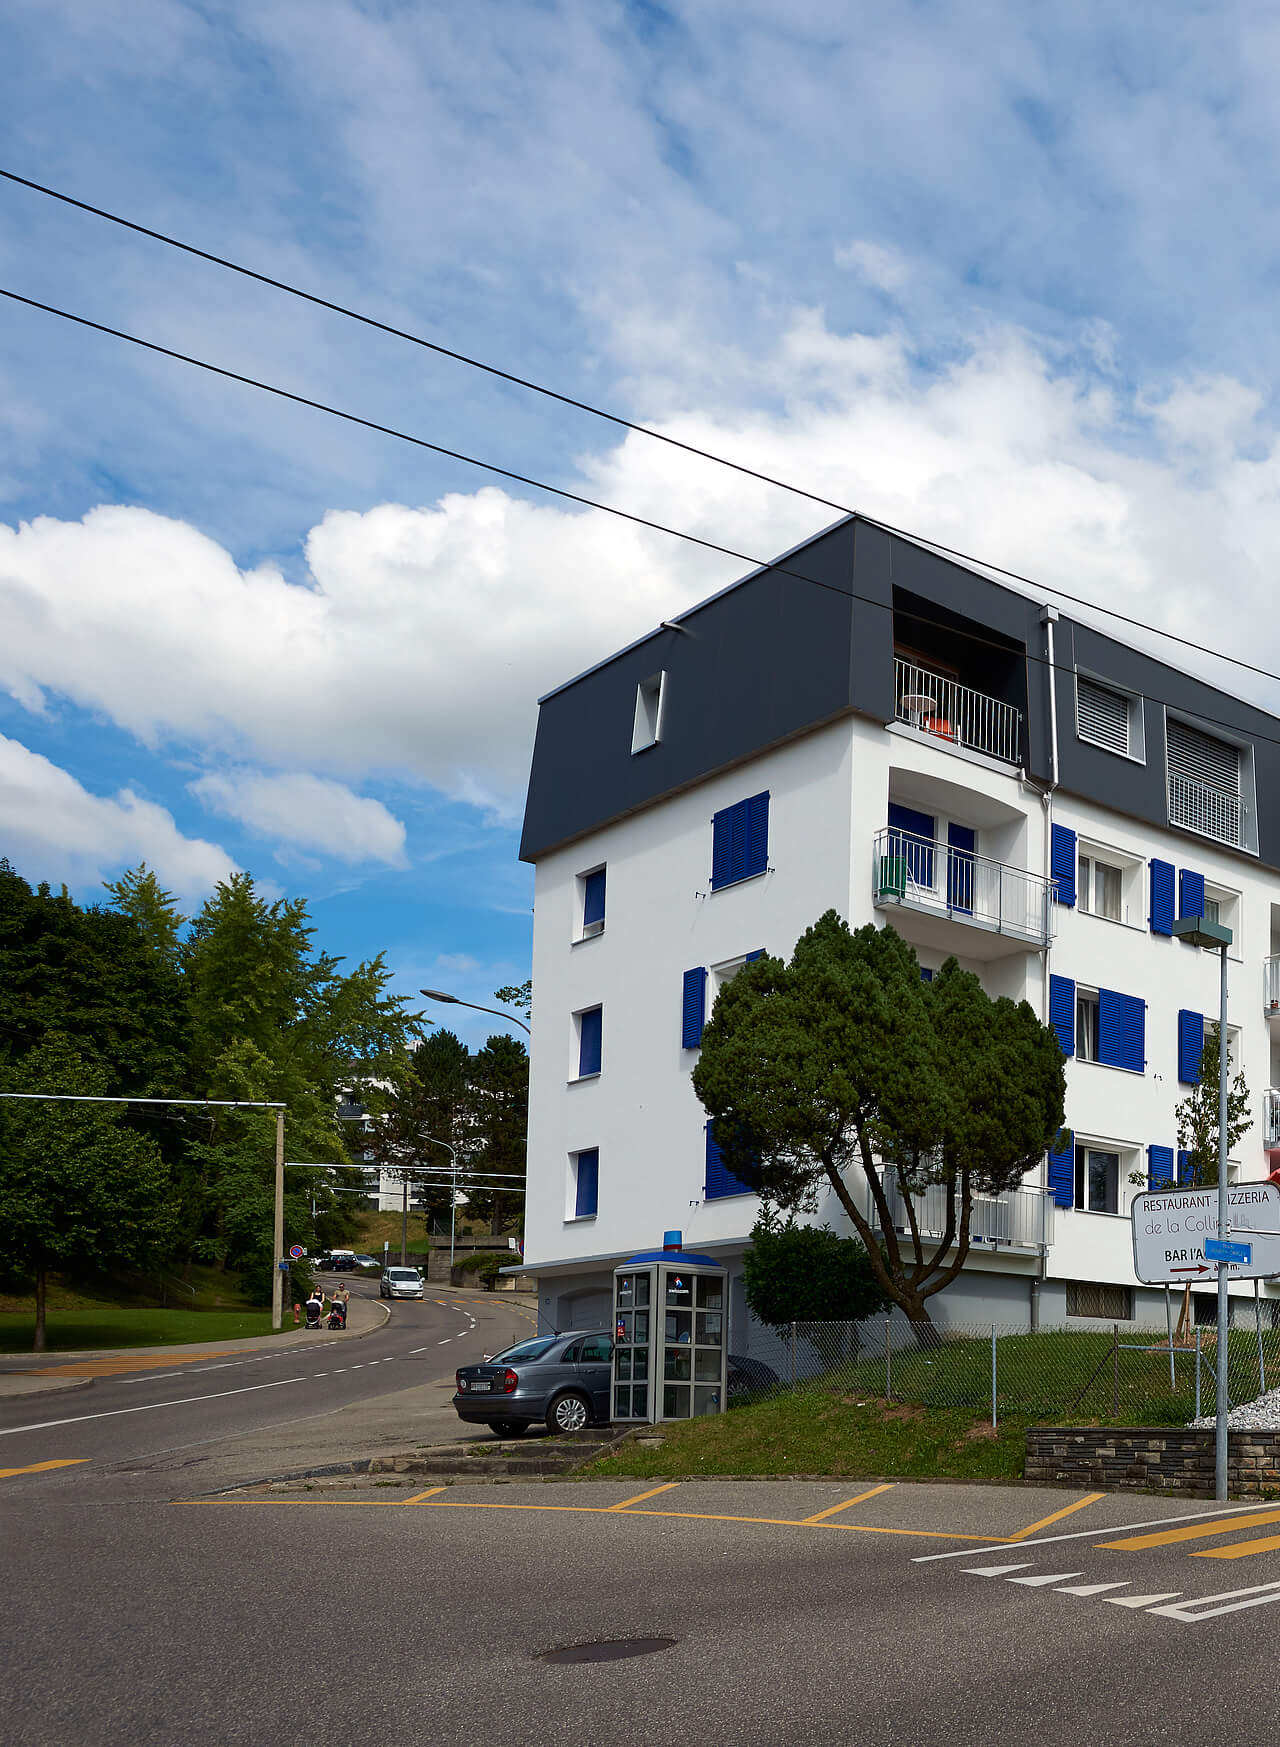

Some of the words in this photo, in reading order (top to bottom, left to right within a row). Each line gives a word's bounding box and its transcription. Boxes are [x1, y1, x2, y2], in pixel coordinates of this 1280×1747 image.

[1143, 1195, 1211, 1212] RESTAURANT
[1227, 1190, 1270, 1205] IZZERIA
[1144, 1217, 1162, 1235] de
[1167, 1216, 1180, 1233] la
[1184, 1214, 1231, 1232] Colli
[1164, 1248, 1188, 1262] BAR
